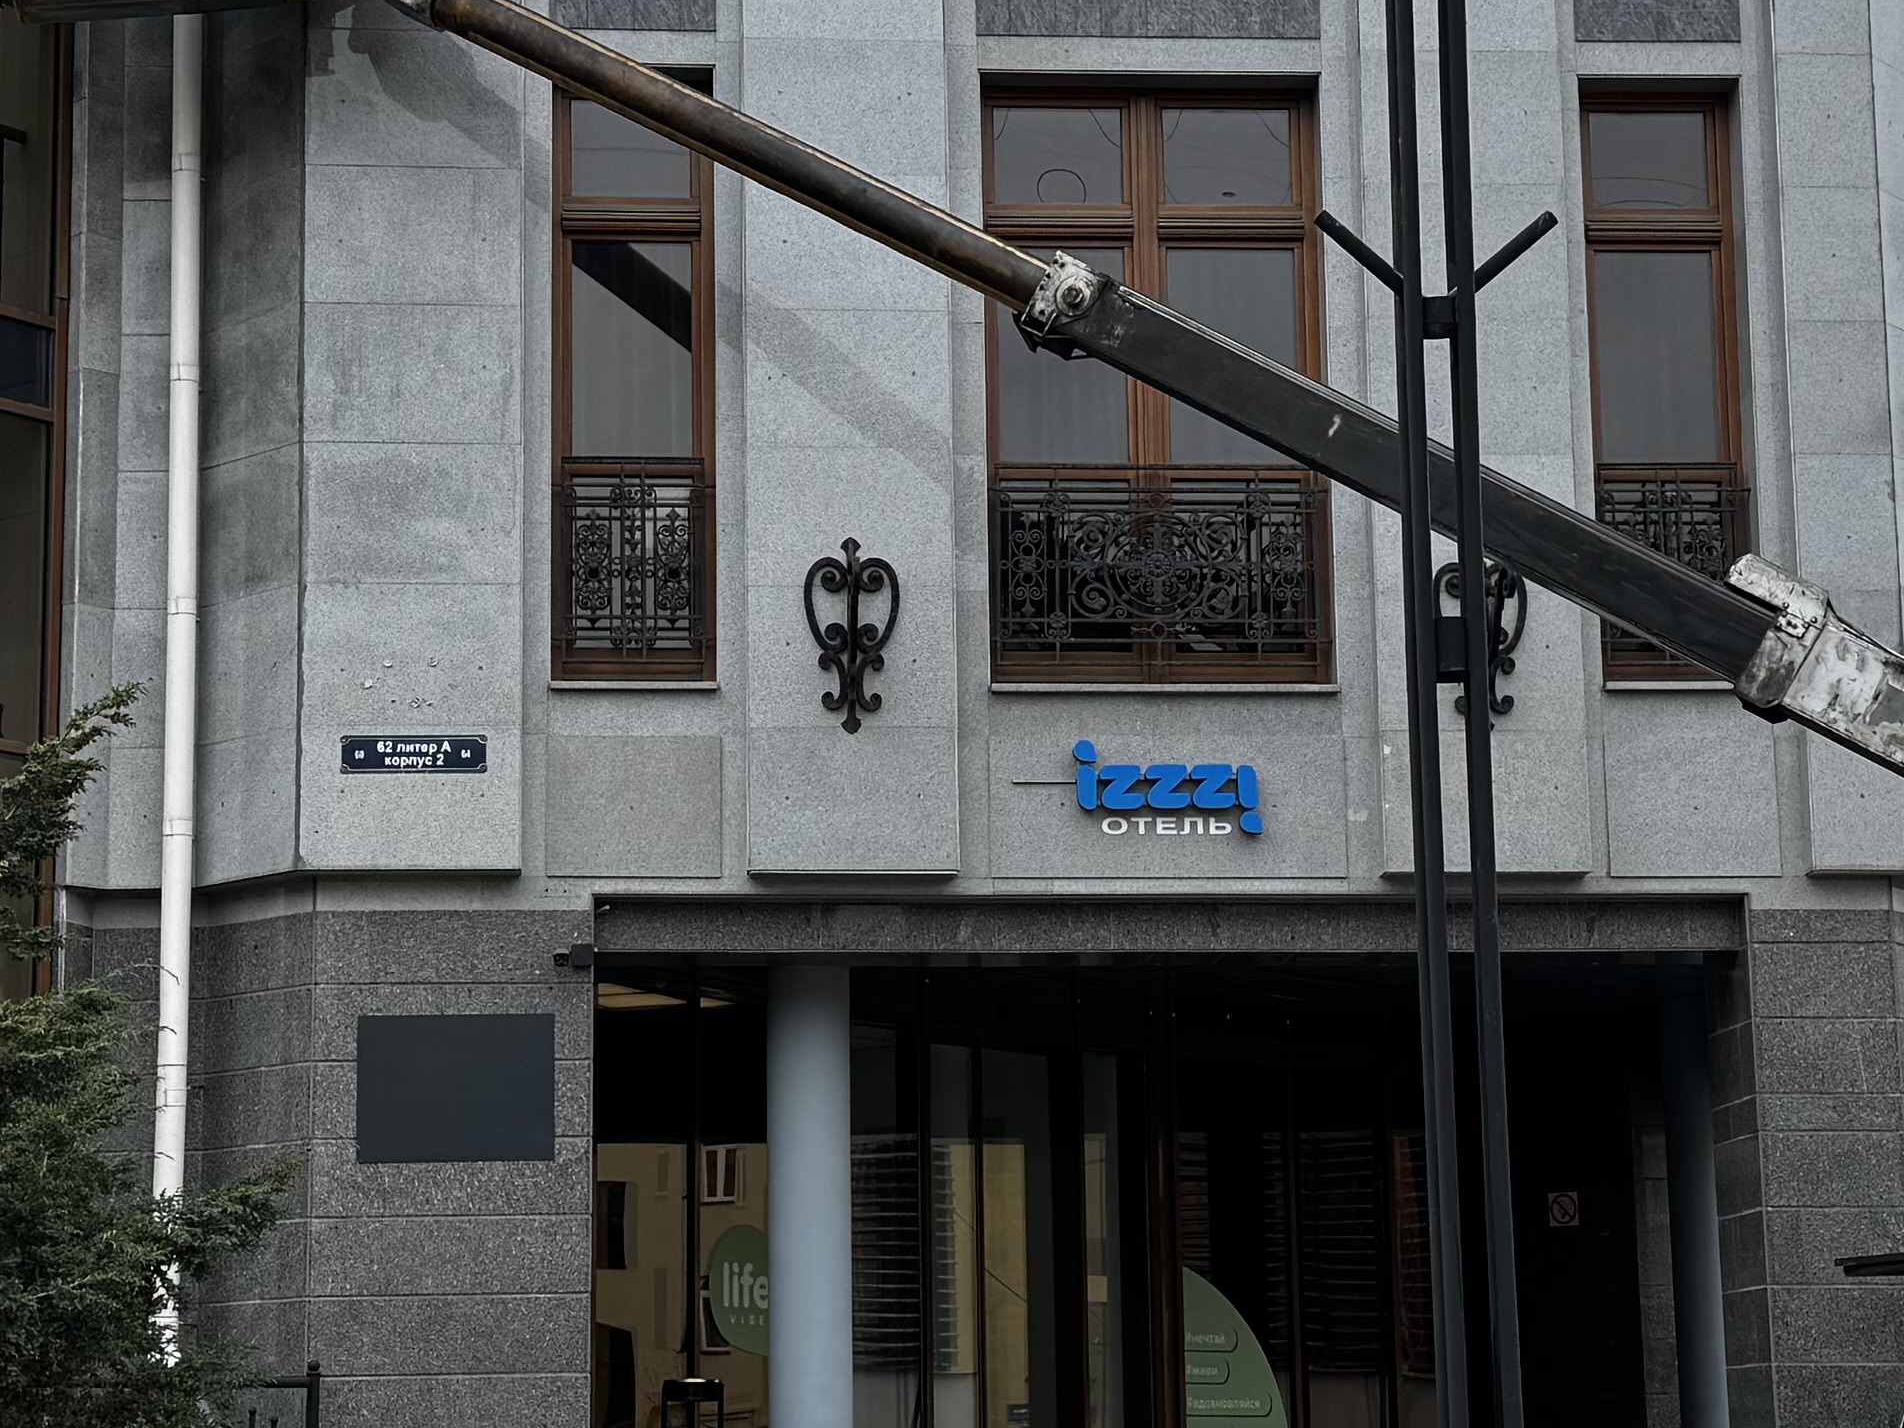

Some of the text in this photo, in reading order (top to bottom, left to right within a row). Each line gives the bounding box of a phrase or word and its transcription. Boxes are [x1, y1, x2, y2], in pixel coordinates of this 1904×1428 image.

[377, 741, 393, 753] 62
[397, 743, 437, 754] литер
[384, 754, 444, 768] корпус 2
[1101, 817, 1232, 835] ОТЕЛЬ
[722, 1261, 769, 1310] life
